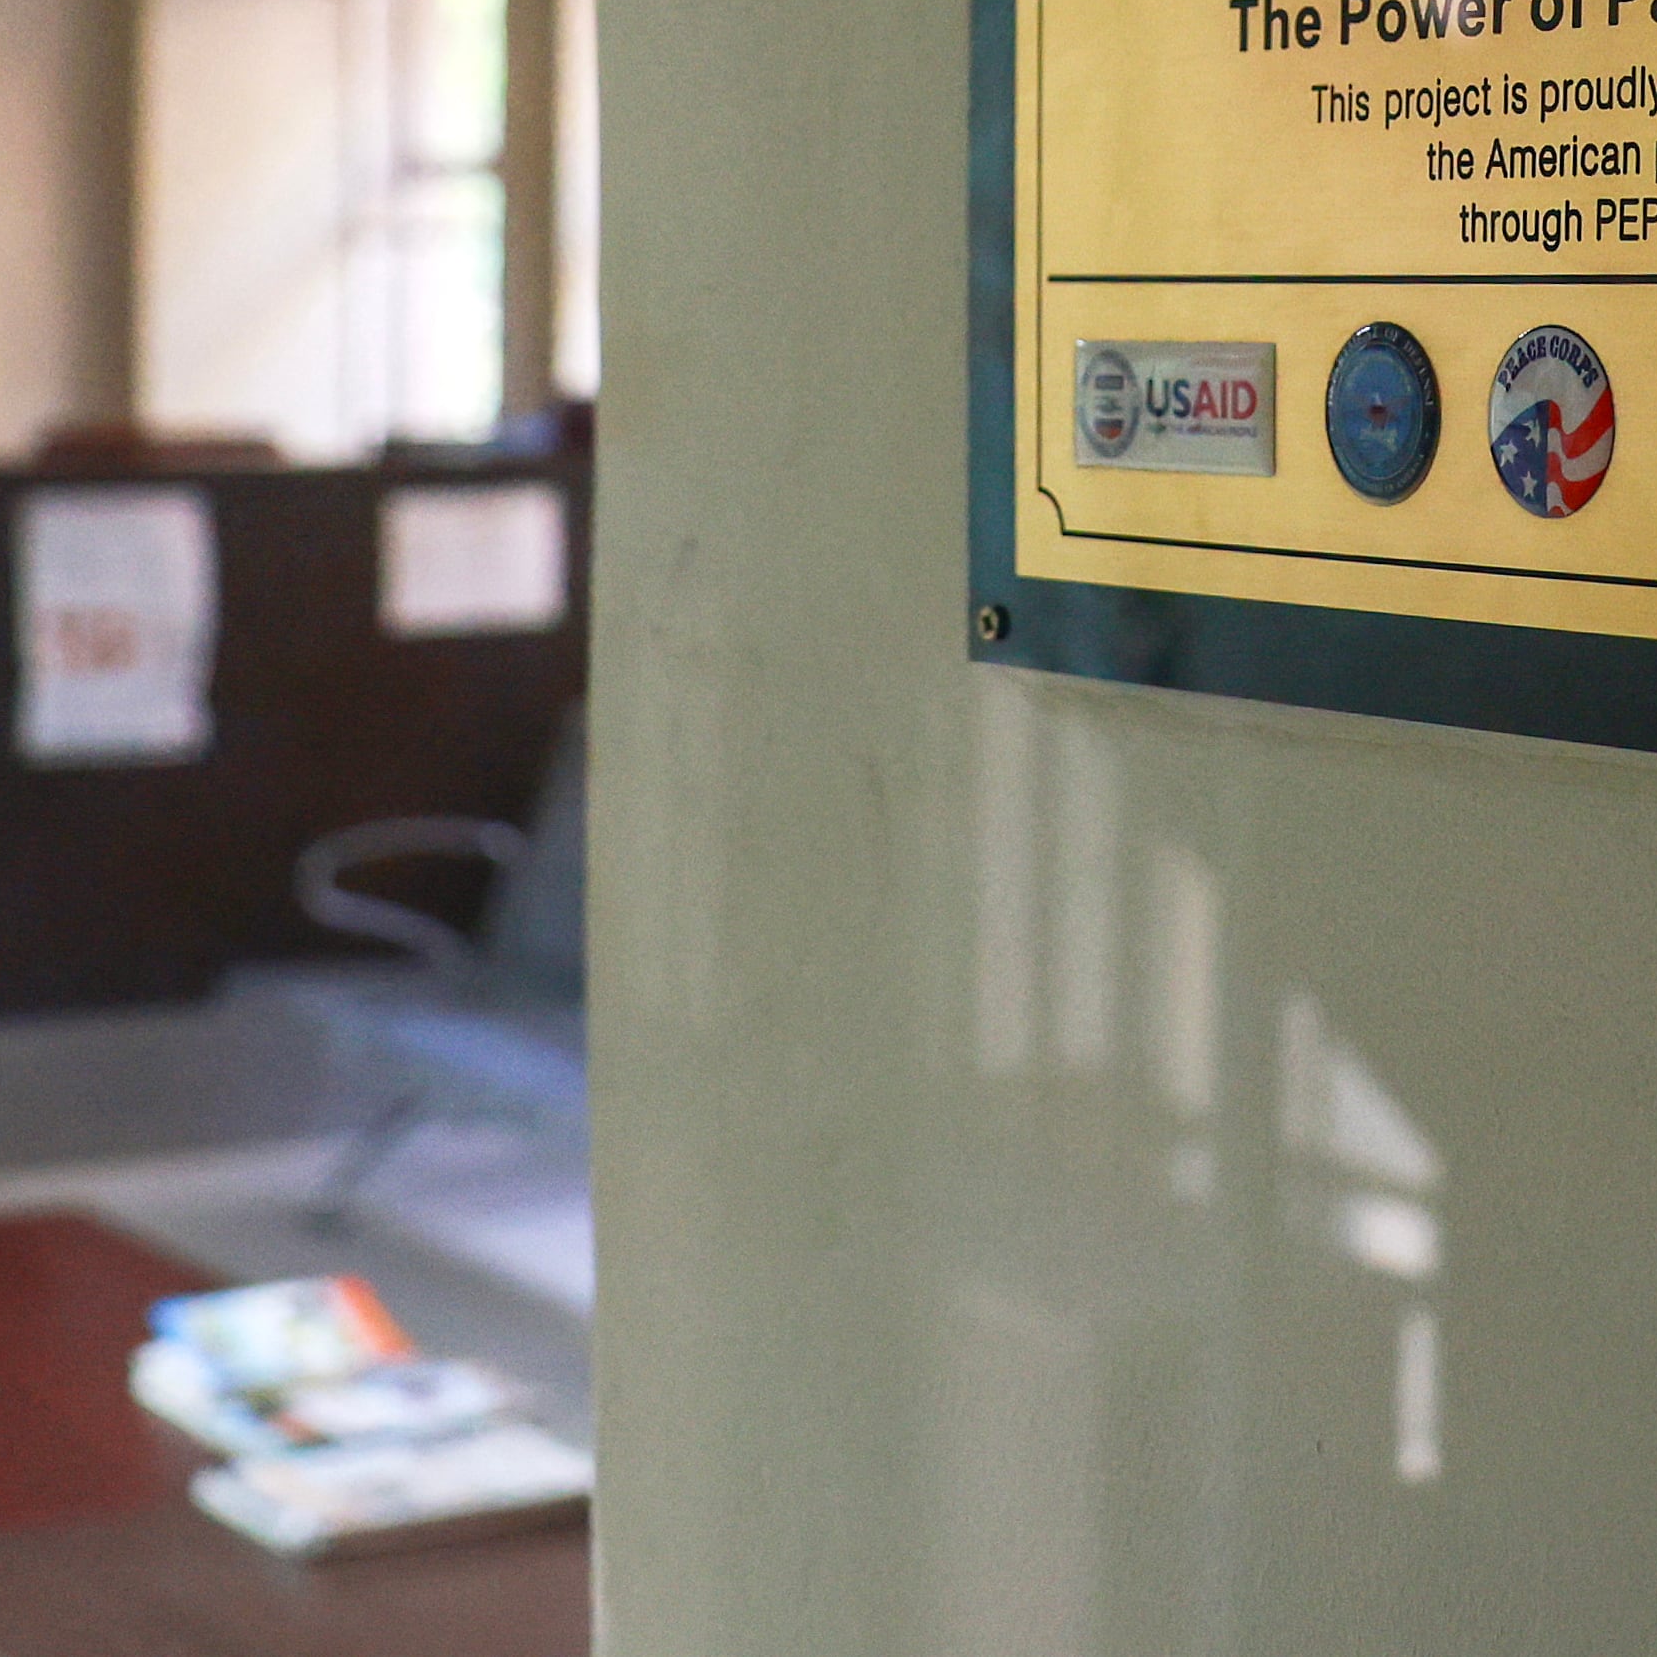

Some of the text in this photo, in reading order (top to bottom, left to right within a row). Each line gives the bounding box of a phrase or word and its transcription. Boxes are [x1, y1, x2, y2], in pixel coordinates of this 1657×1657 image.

[1311, 81, 1371, 125] This
[1384, 75, 1493, 132] project
[1502, 71, 1529, 116] is
[1425, 139, 1476, 182] the
[1483, 135, 1642, 181] American
[1457, 198, 1584, 254] through
[1498, 334, 1600, 393] PEACE CORPS
[1145, 378, 1259, 421] USAID
